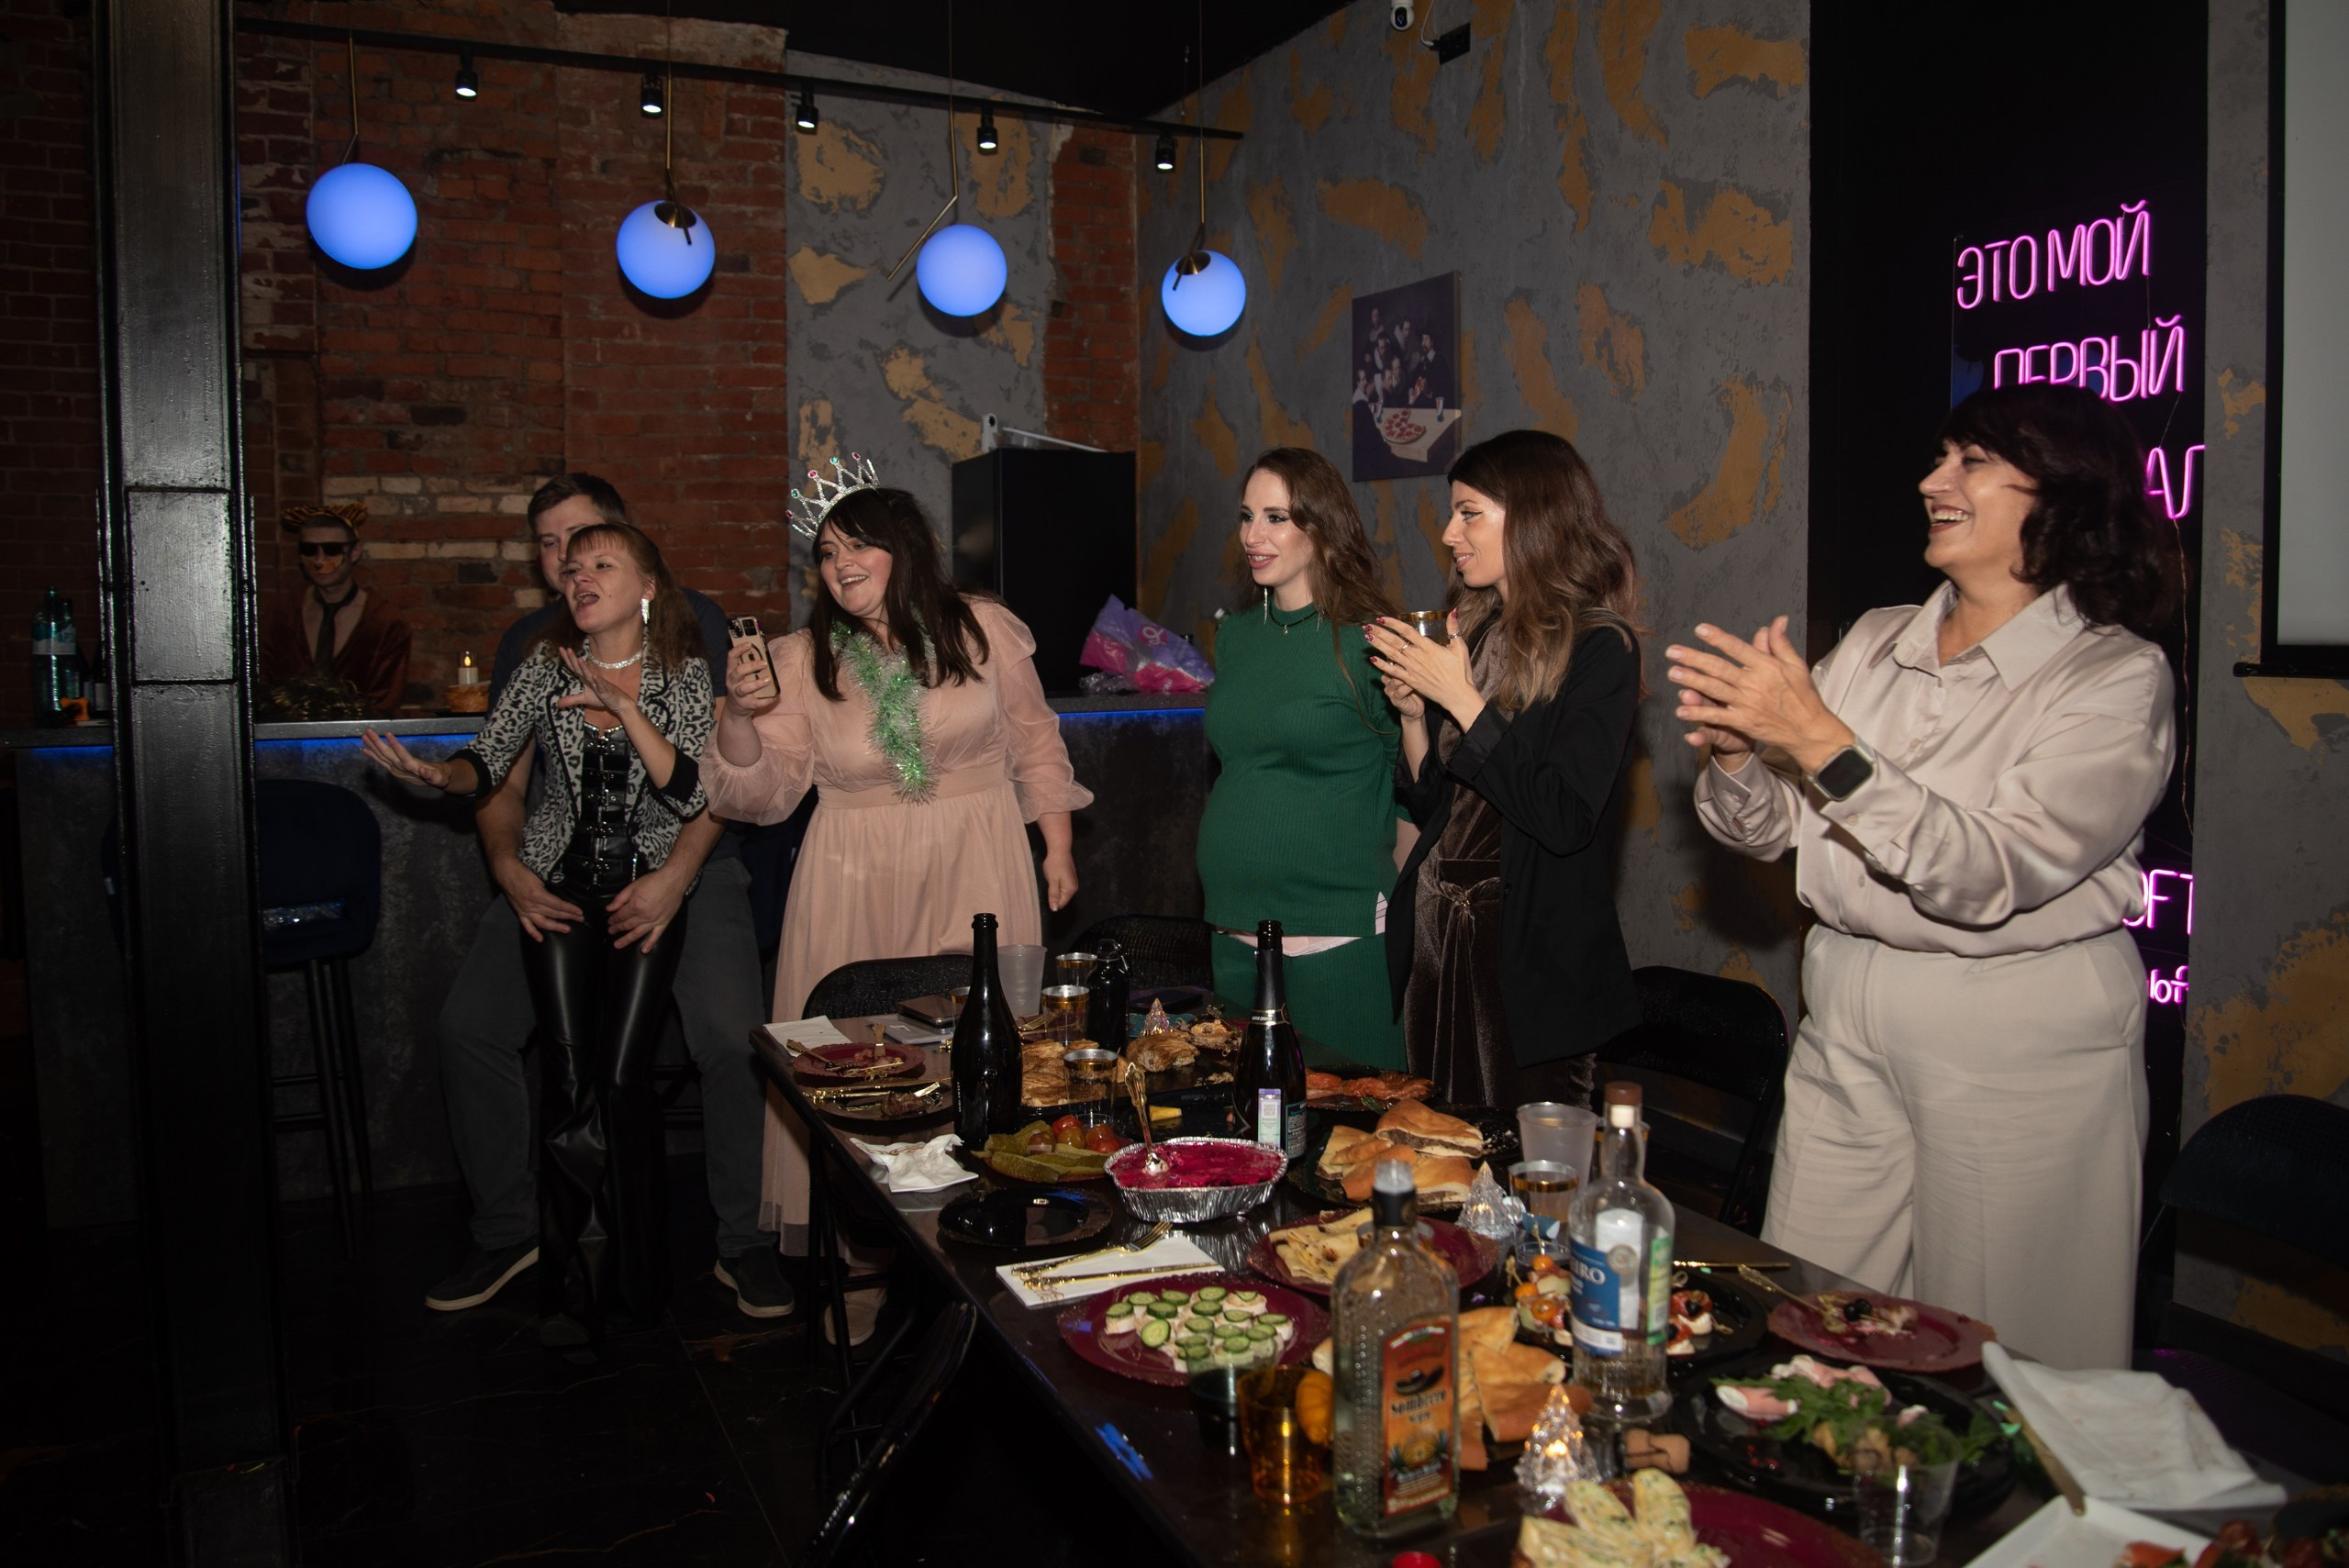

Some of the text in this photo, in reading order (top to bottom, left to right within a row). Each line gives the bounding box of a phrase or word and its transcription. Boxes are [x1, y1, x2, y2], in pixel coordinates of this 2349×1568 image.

[1956, 199, 2150, 309] ЭТО МОЙ
[1993, 314, 2185, 402] ПЕРВЫЙ
